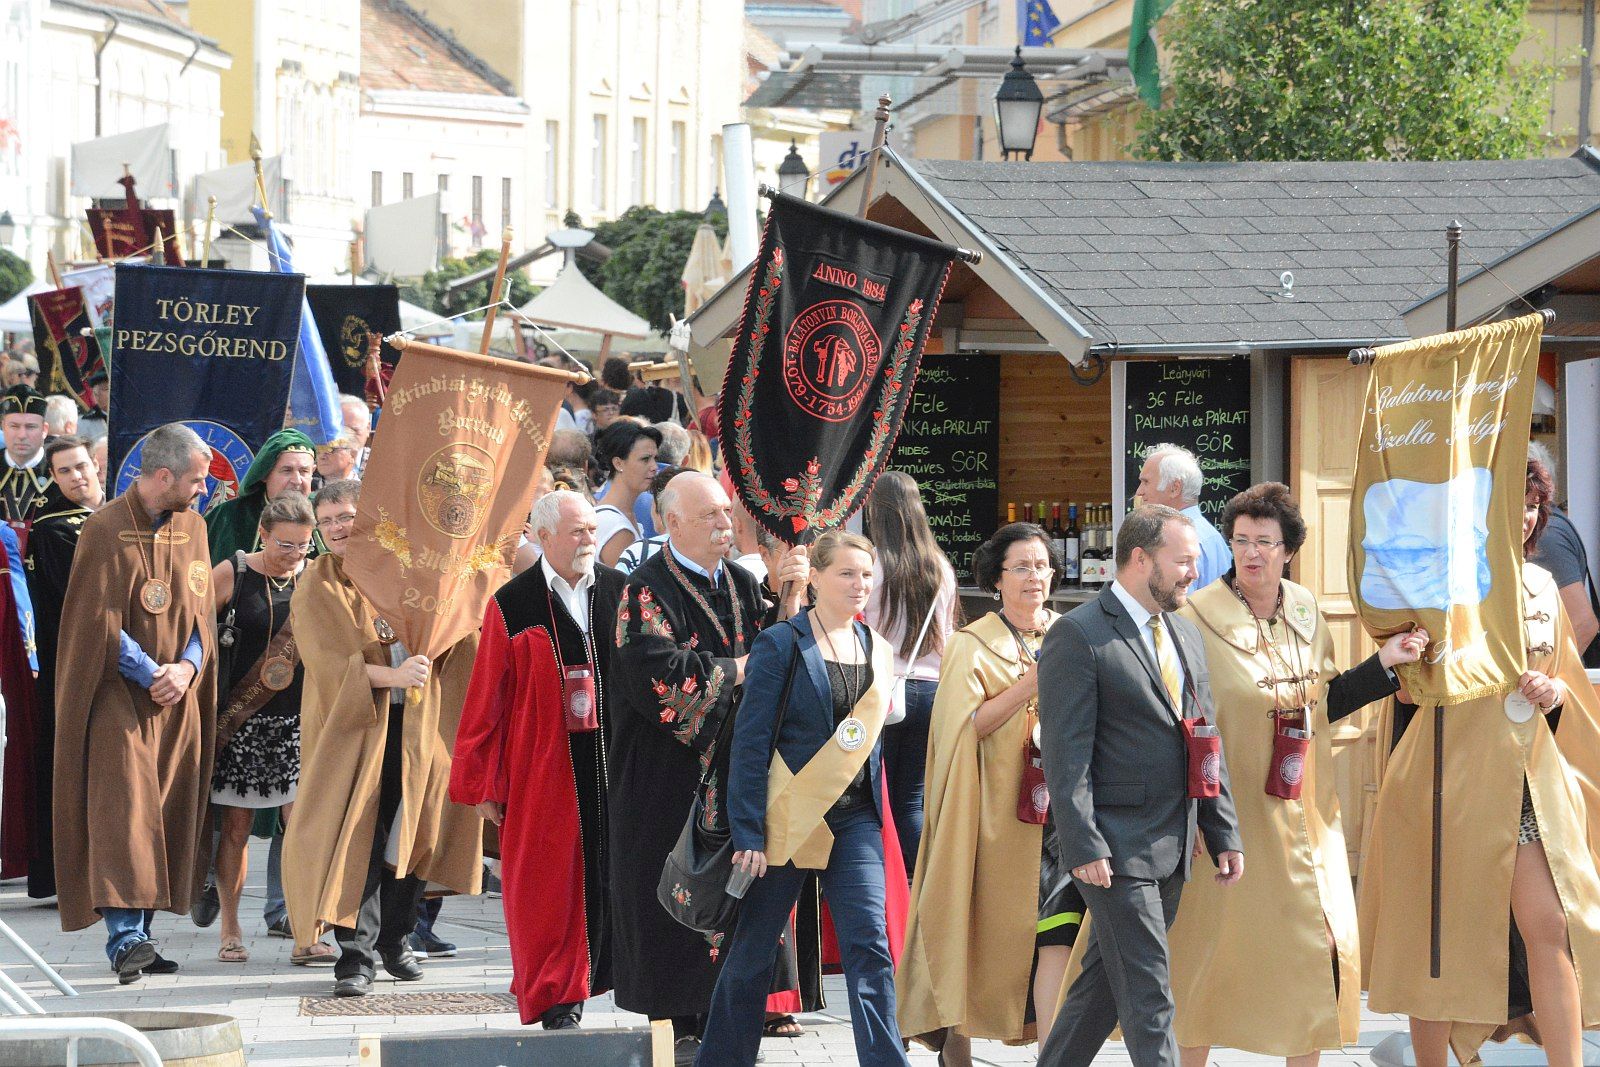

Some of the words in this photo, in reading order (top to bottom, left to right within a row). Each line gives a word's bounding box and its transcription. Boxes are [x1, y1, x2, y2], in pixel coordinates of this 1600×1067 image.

[812, 262, 858, 288] ANNO
[862, 277, 886, 300] 1984
[156, 296, 261, 326] TÖRLEY
[116, 330, 287, 361] PEZSGŐREND
[1163, 363, 1211, 386] Leányvári
[1146, 391, 1167, 409] 36
[1174, 391, 1204, 407] Féle
[1368, 379, 1453, 414] Balatoni
[900, 420, 929, 436] NKA
[943, 419, 991, 436] PÁRLAT
[1135, 413, 1189, 431] PÁLINKA
[1192, 416, 1204, 427] és
[1205, 408, 1250, 426] PÁRLAT
[898, 446, 931, 456] HIDEG
[1196, 431, 1234, 453] SÖR
[951, 450, 988, 472] SÖR
[927, 509, 972, 527] ONÁDÉ
